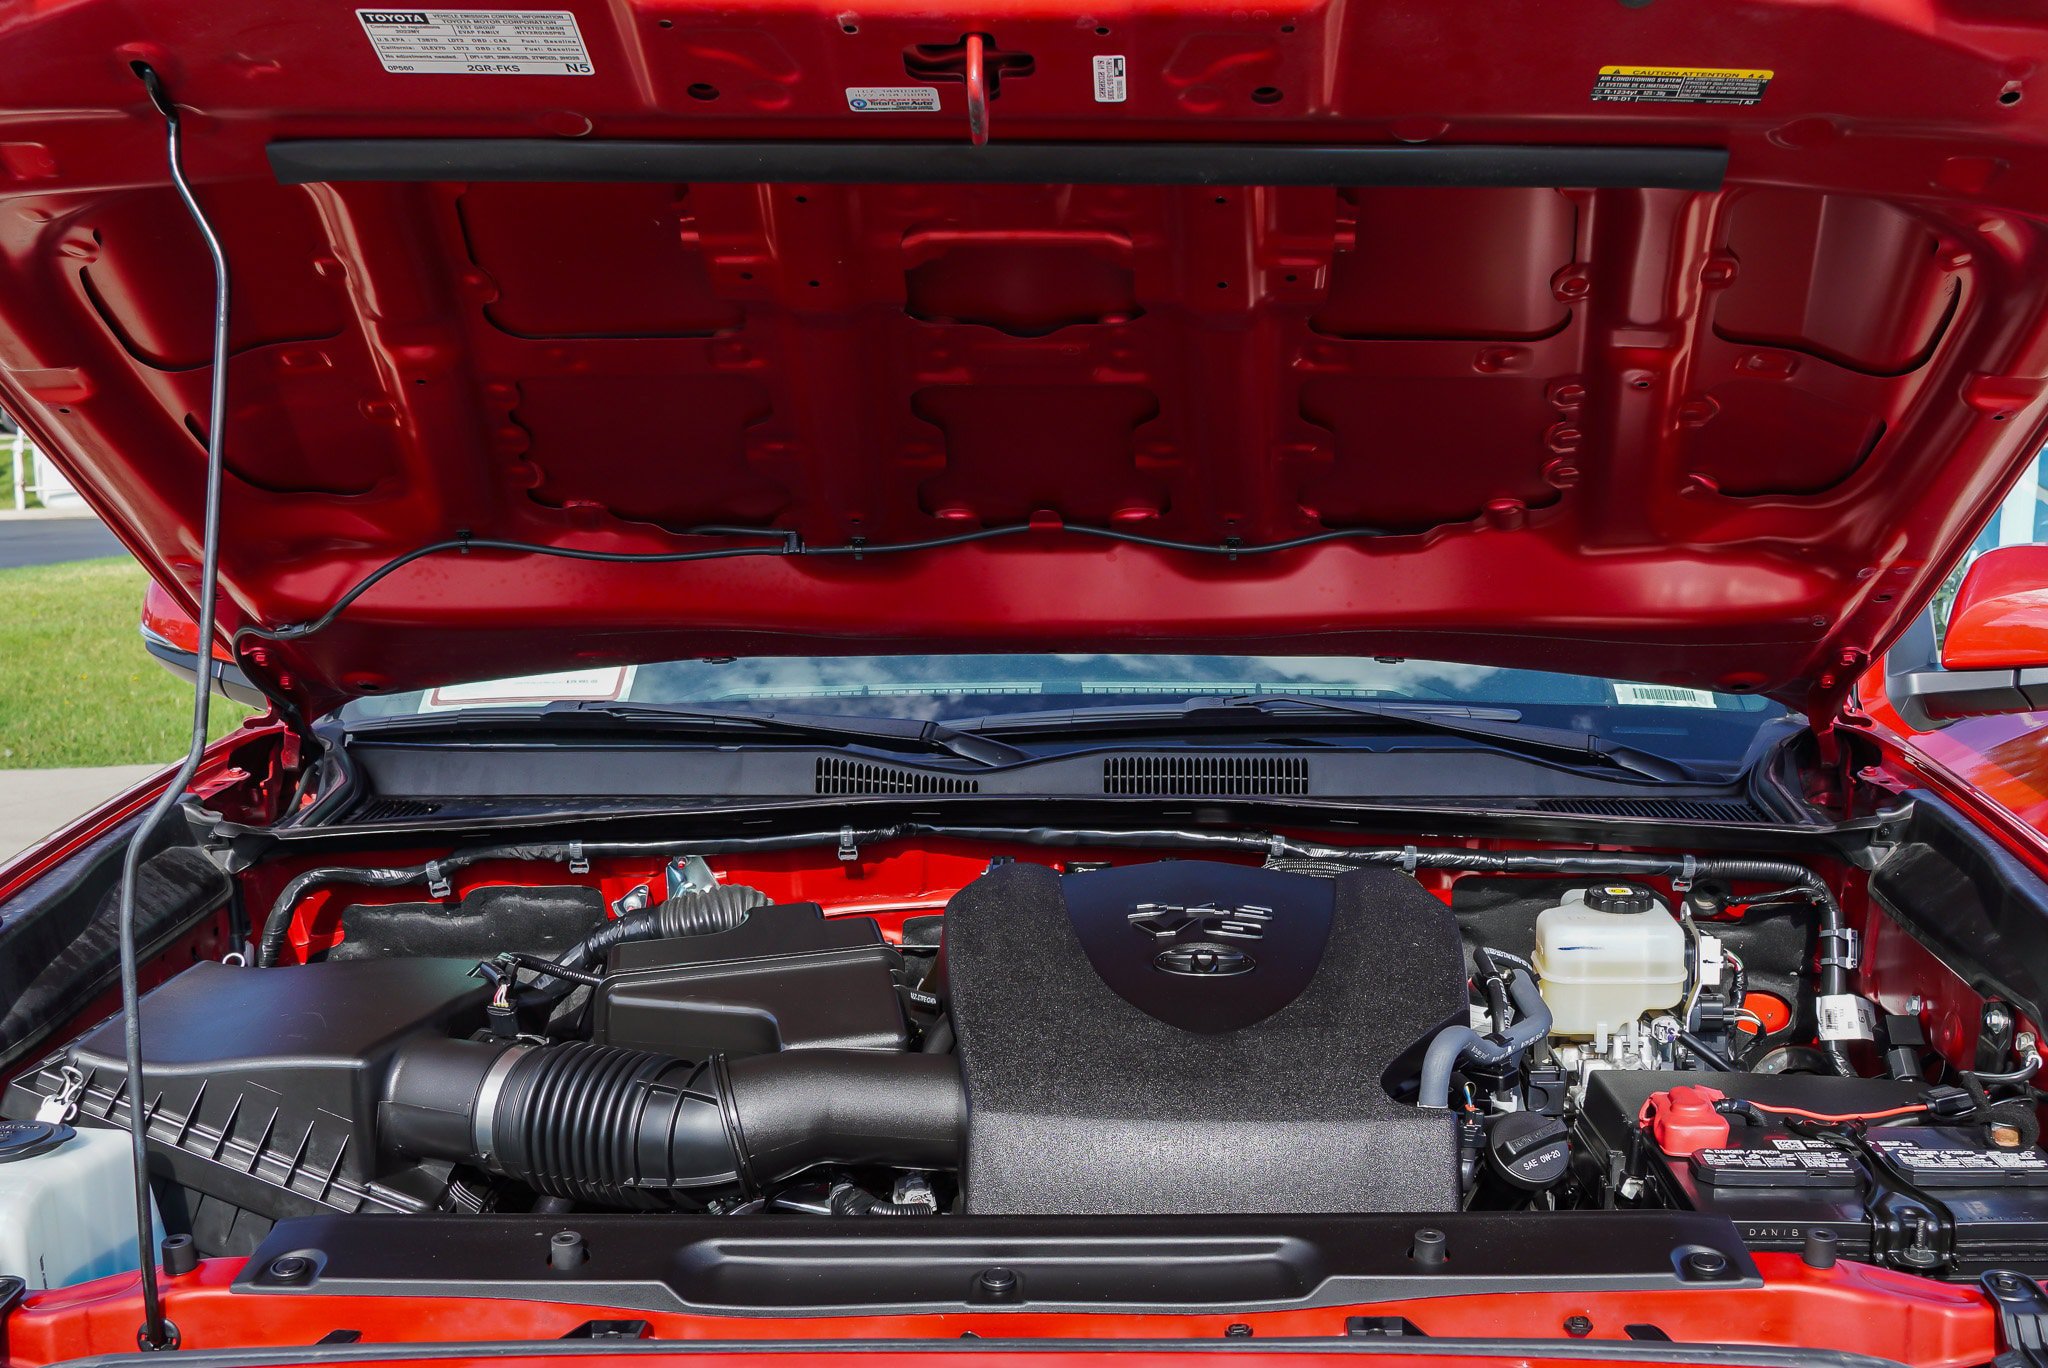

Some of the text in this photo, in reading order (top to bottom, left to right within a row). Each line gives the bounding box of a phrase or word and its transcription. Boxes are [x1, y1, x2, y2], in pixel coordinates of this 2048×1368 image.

[365, 13, 424, 22] TOYOTA
[566, 63, 591, 73] N5
[1523, 1150, 1561, 1170] SAE 0W-20
